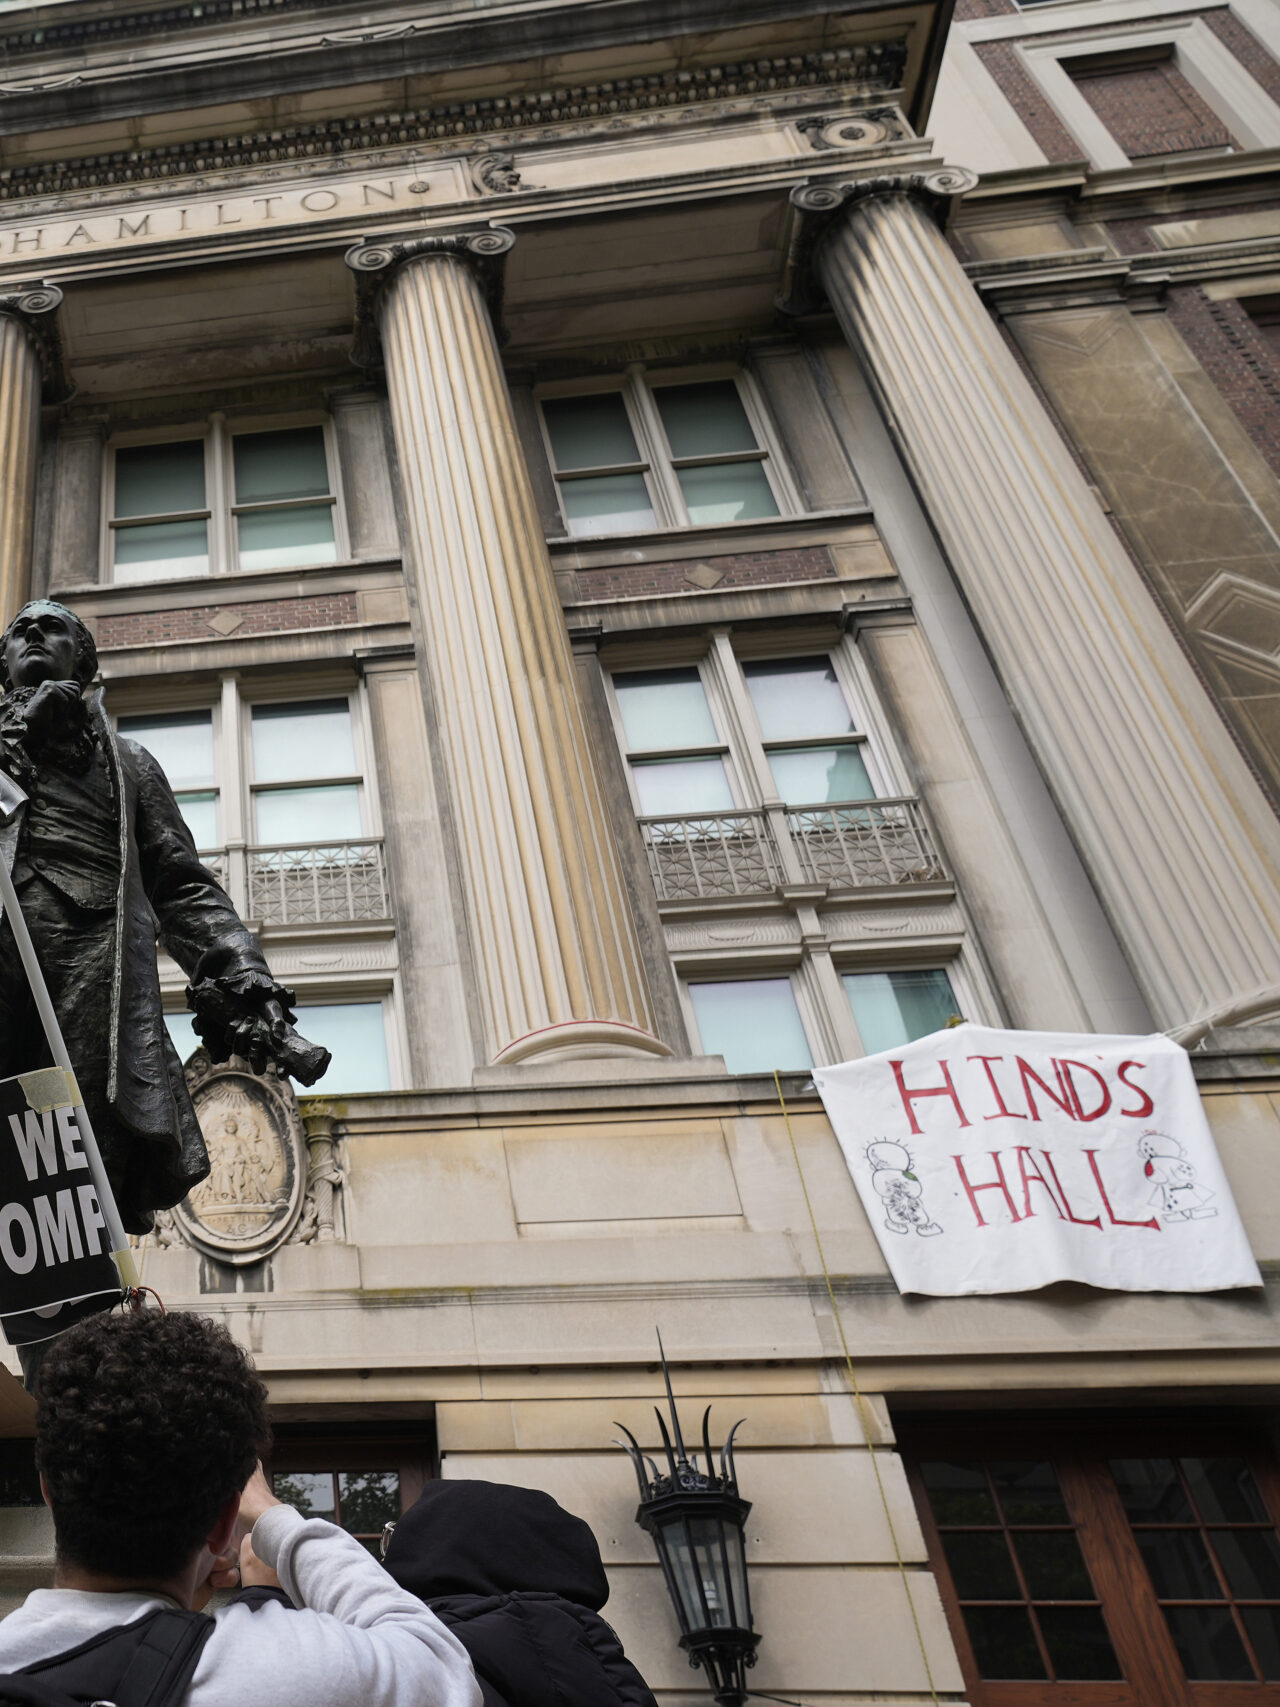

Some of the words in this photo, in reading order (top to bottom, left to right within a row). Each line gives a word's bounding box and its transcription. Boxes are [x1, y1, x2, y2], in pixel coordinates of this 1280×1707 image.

[8, 181, 399, 254] HAMILTON
[7, 1106, 89, 1182] WE
[949, 1146, 1162, 1232] HALL
